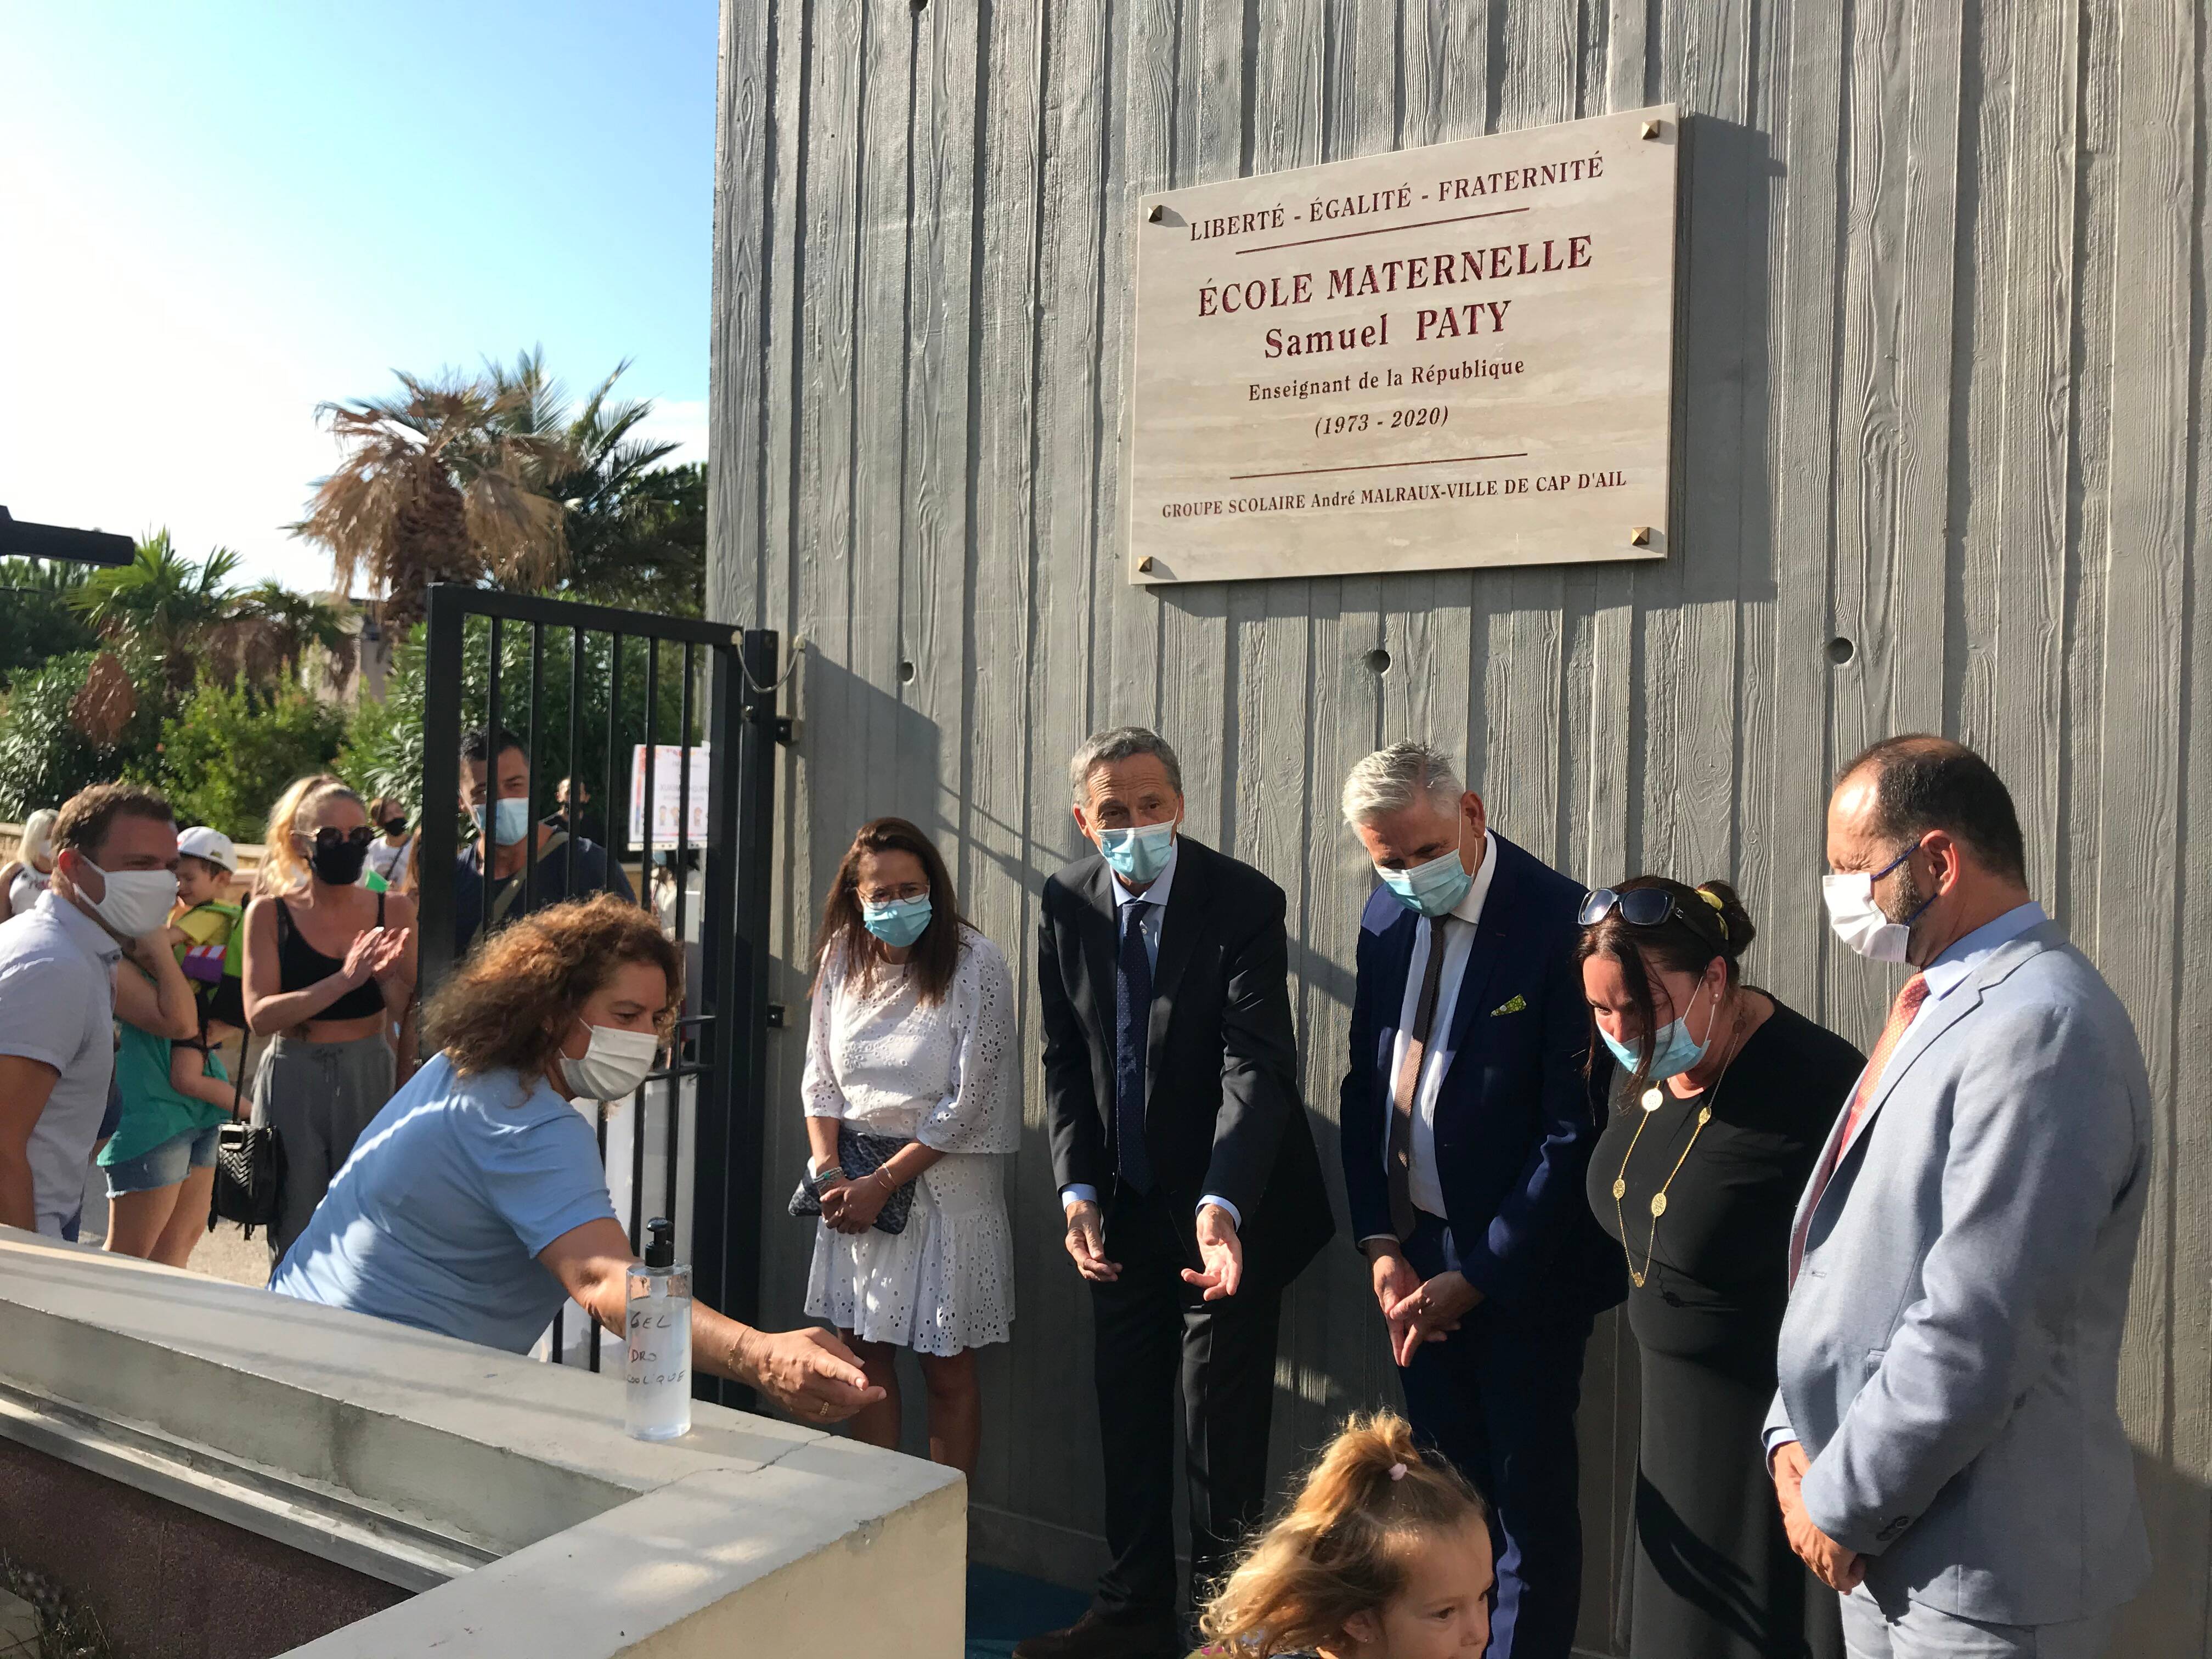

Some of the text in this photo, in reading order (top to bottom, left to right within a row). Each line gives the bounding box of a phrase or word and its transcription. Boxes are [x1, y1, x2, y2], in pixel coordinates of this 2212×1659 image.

[1190, 203, 1285, 241] LIBERTÉ
[1309, 182, 1411, 223] ÉGALITÉ
[1438, 150, 1604, 202] FRATERNITÉ
[1198, 234, 1593, 317] ÉCOLE MATERNELLE
[1265, 300, 1513, 359] Samuel PATY
[1249, 359, 1525, 401] Enseignant de la République
[1315, 414, 1369, 438] (1973
[1390, 405, 1448, 428] 2020)
[1162, 500, 1223, 518] GROUPE
[1228, 494, 1306, 514] SCOLAIRE
[1311, 490, 1355, 508] André
[1504, 478, 1529, 495] DE
[1536, 475, 1571, 492] CAP
[1577, 471, 1628, 489] D'AIL
[630, 1311, 671, 1329] GEL
[629, 1347, 657, 1363] DRO
